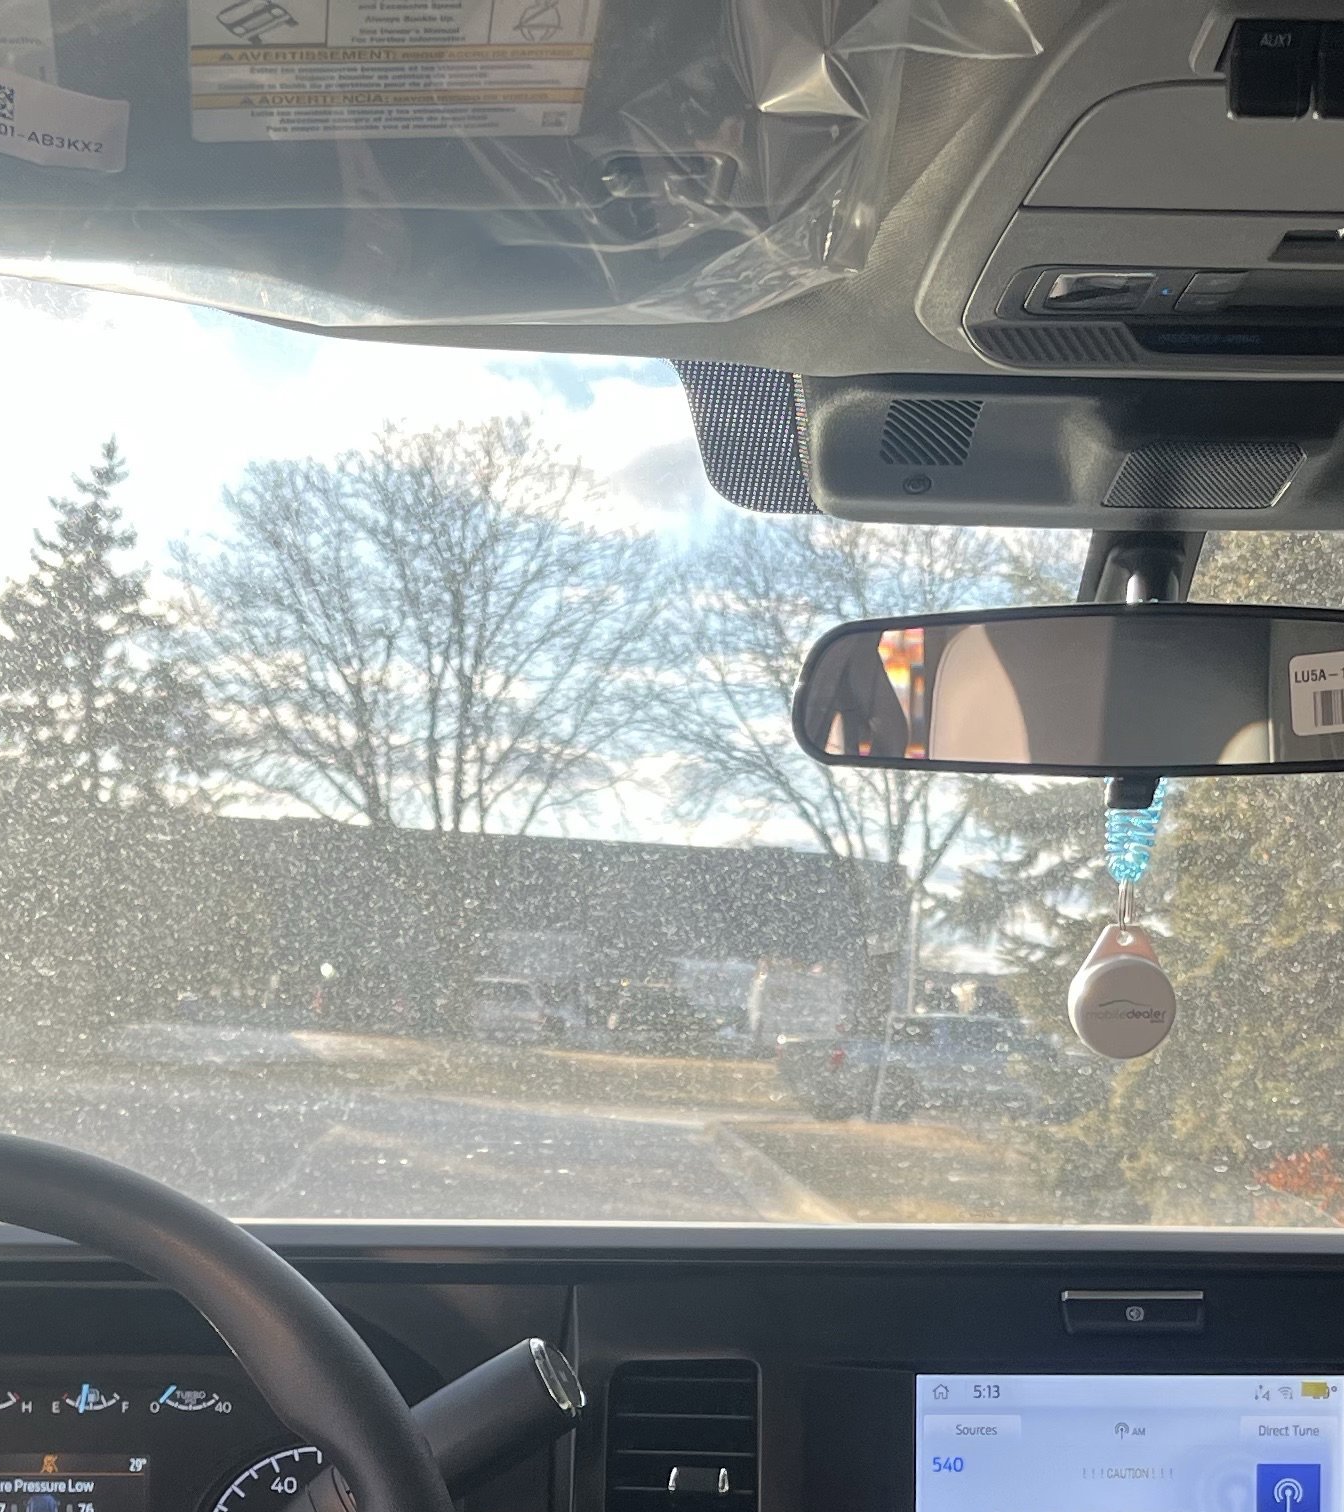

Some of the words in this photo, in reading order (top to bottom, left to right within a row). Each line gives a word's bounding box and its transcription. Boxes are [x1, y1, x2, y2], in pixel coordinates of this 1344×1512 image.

[1260, 33, 1291, 48] AUX1
[973, 1384, 1001, 1399] 5:13
[21, 1401, 33, 1413] H
[51, 1401, 61, 1413] E
[121, 1401, 130, 1413] F
[214, 1401, 232, 1414] 40
[955, 1424, 998, 1436] Sources
[1132, 1427, 1146, 1437] AM
[1258, 1425, 1289, 1437] Direct
[1294, 1425, 1320, 1437] Tune
[932, 1456, 964, 1472] 540
[14, 1479, 66, 1493] Pressure
[68, 1479, 94, 1493] Low
[270, 1477, 298, 1494] 40
